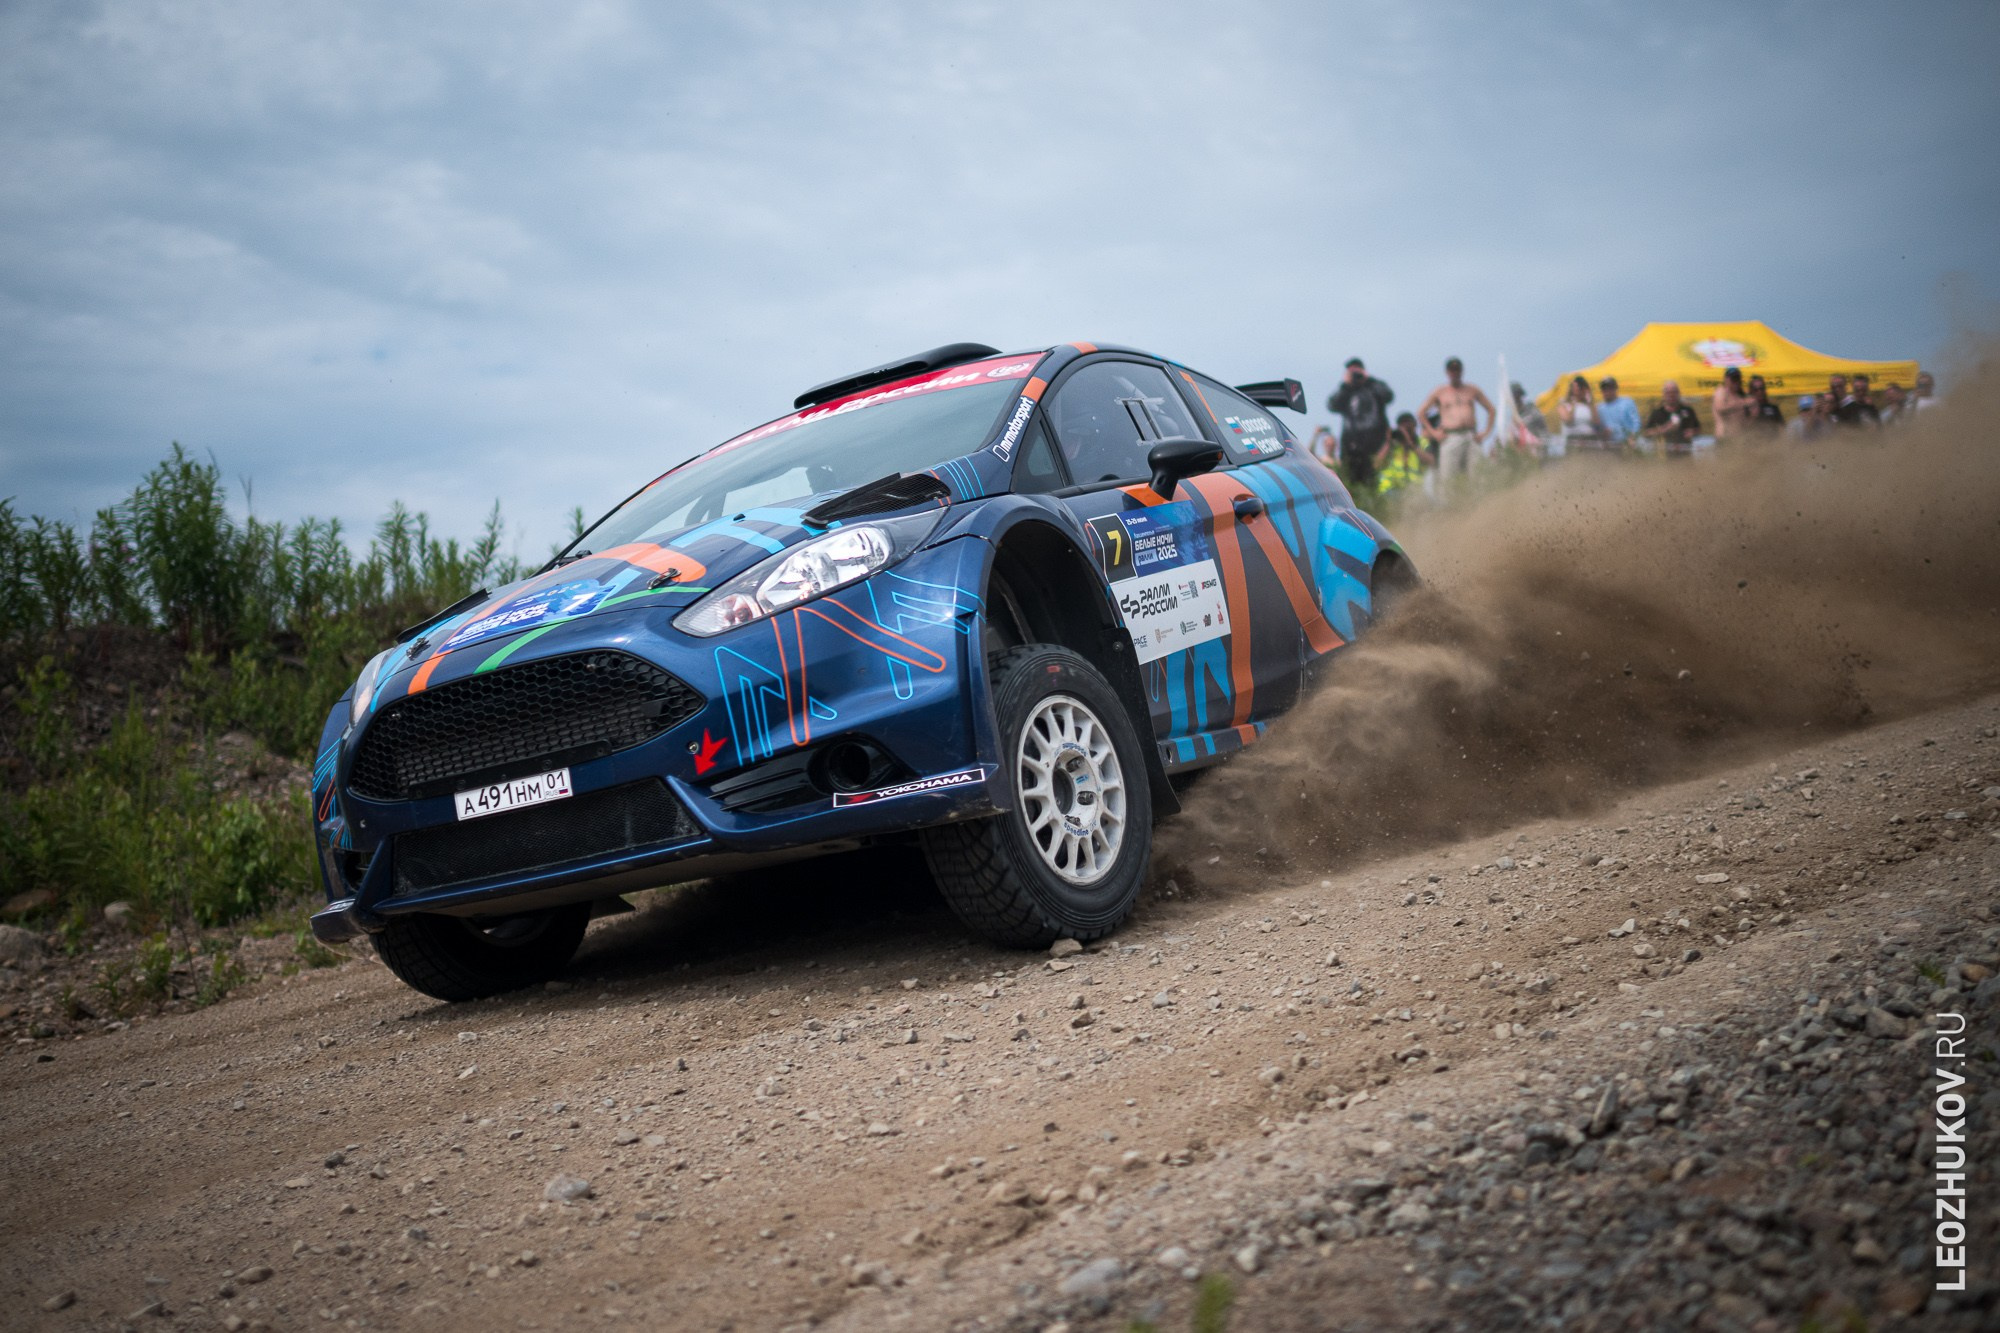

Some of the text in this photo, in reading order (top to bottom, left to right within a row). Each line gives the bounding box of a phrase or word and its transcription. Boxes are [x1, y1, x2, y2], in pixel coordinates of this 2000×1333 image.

[1001, 396, 1034, 452] mrmotorsport
[1107, 530, 1121, 565] 7
[1135, 537, 1156, 551] БЕЛЫЕ
[1156, 533, 1174, 546] НОЧИ
[1157, 543, 1178, 560] 2025
[561, 592, 597, 612] 7
[1139, 582, 1171, 604] РАЛЛИ
[1141, 595, 1178, 619] РОССИИ
[876, 774, 973, 798] YOKOHAMA
